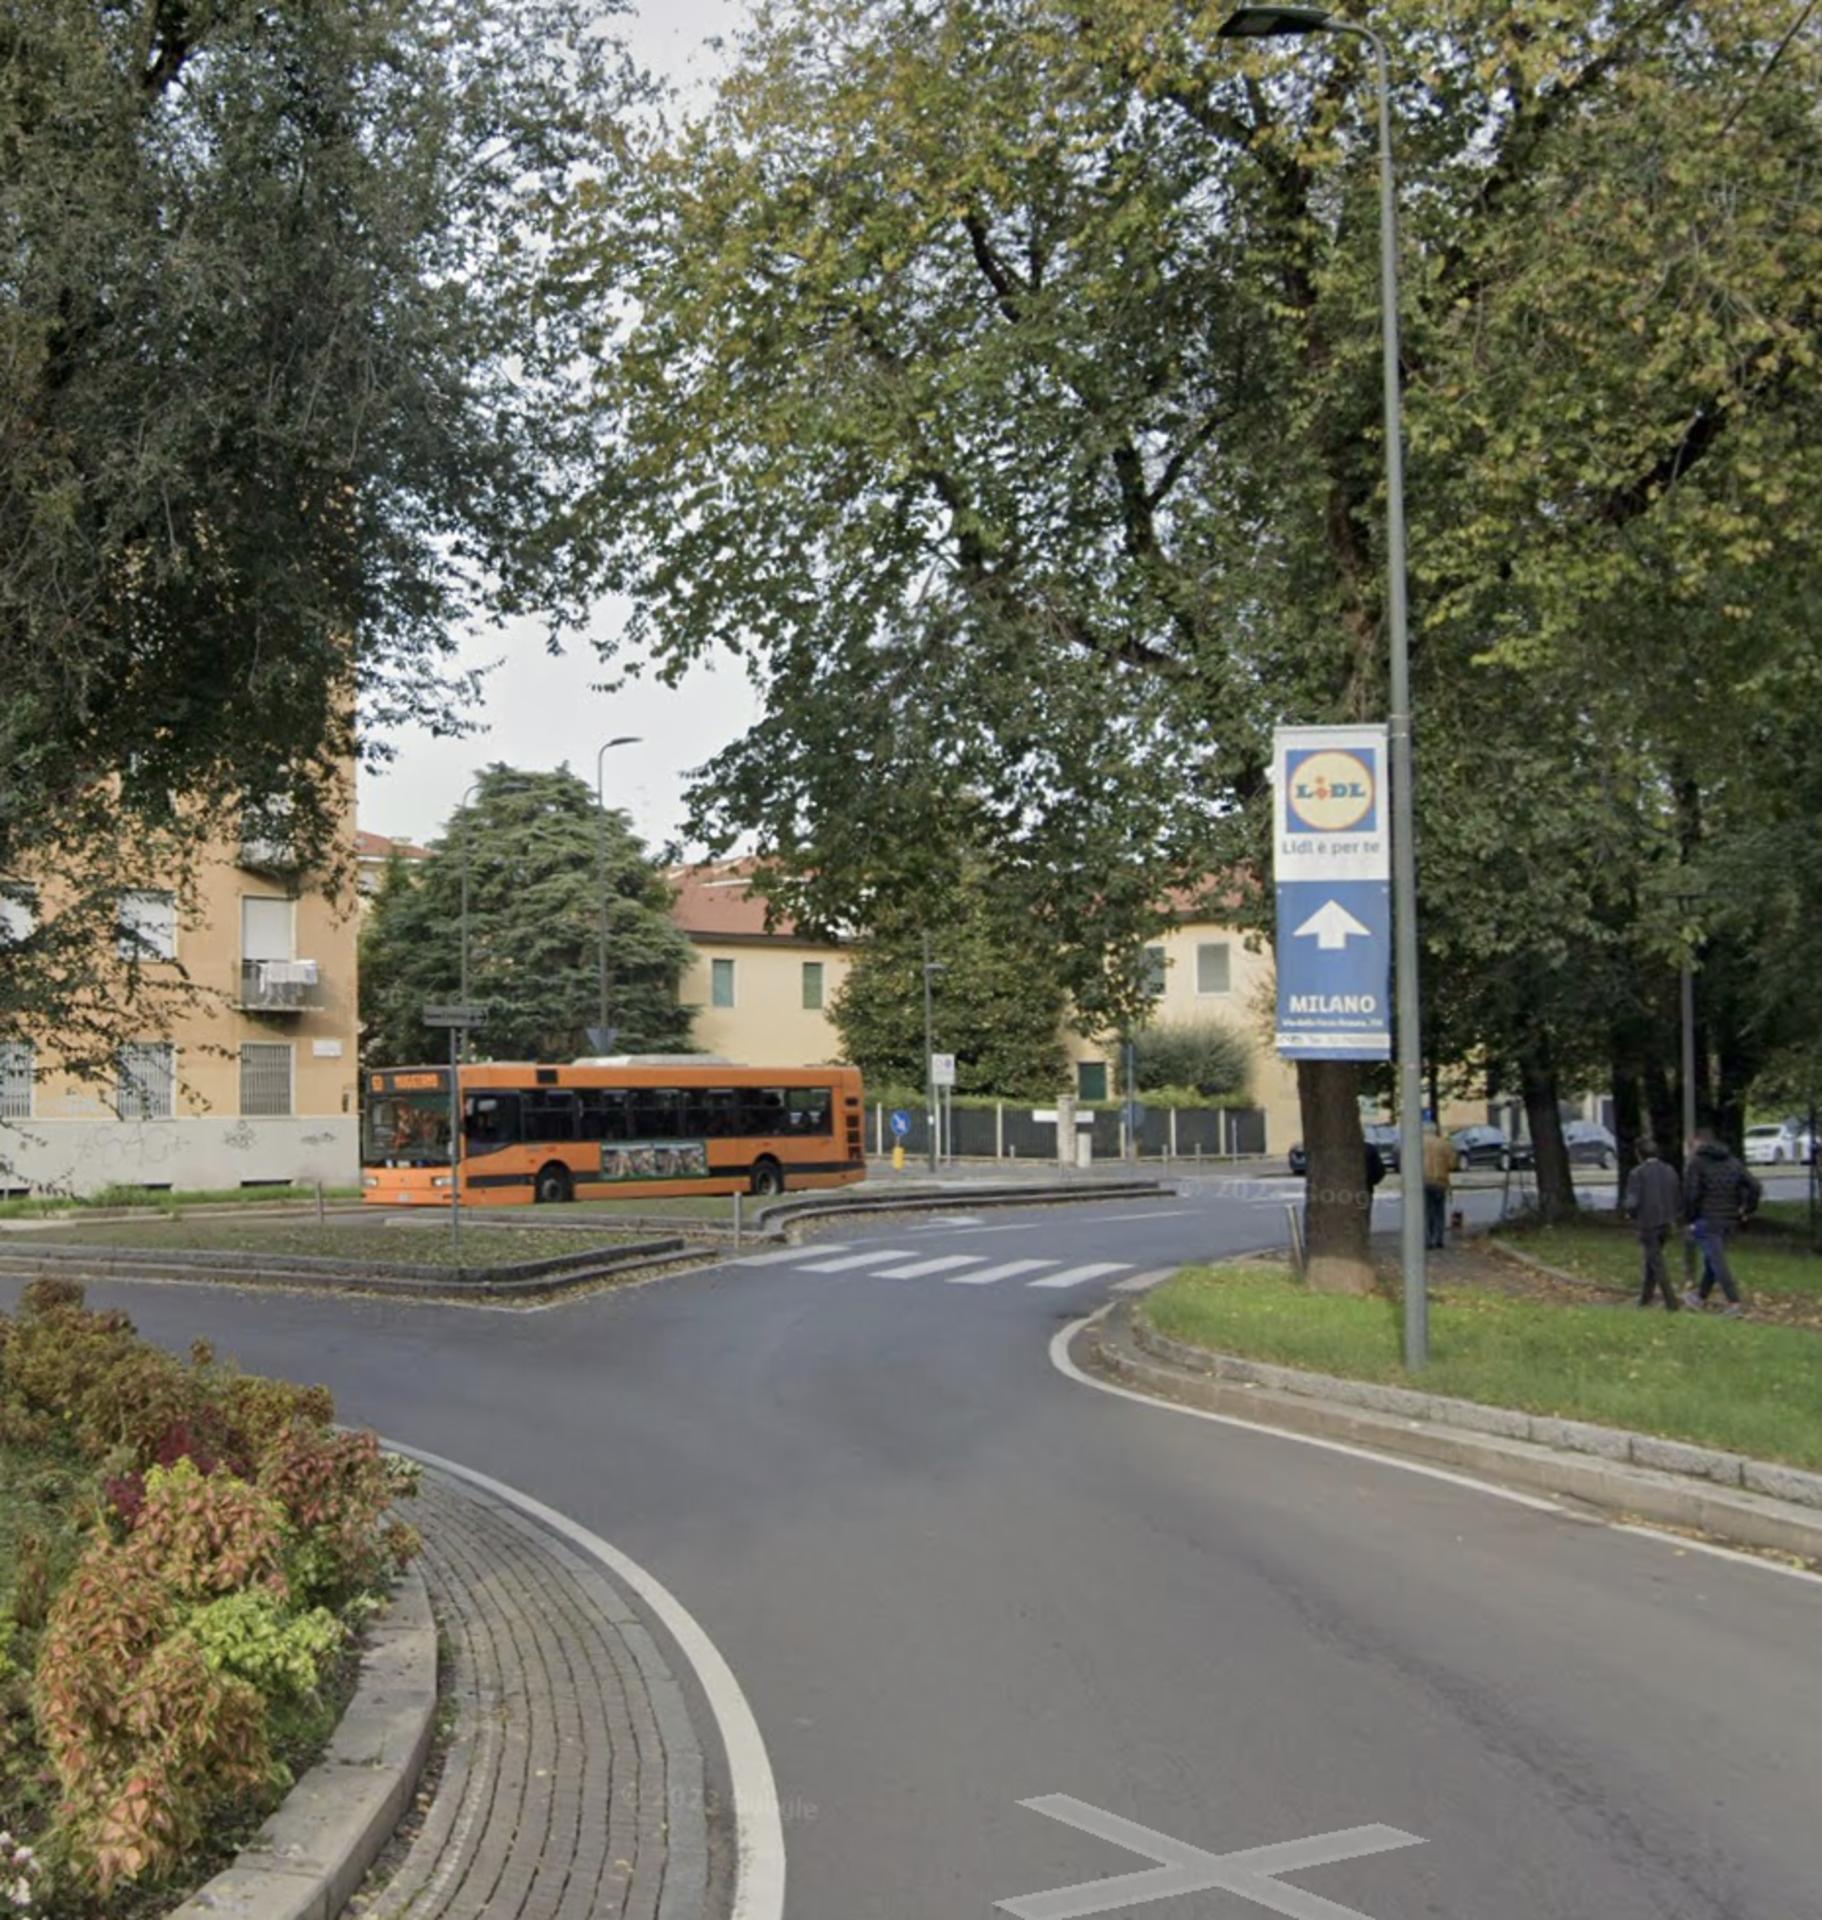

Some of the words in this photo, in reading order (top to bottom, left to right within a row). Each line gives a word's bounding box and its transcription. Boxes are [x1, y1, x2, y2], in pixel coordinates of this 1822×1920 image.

[1282, 840, 1313, 855] Lidl
[1331, 842, 1358, 856] per
[1362, 841, 1380, 854] te
[1289, 995, 1377, 1014] MILANO
